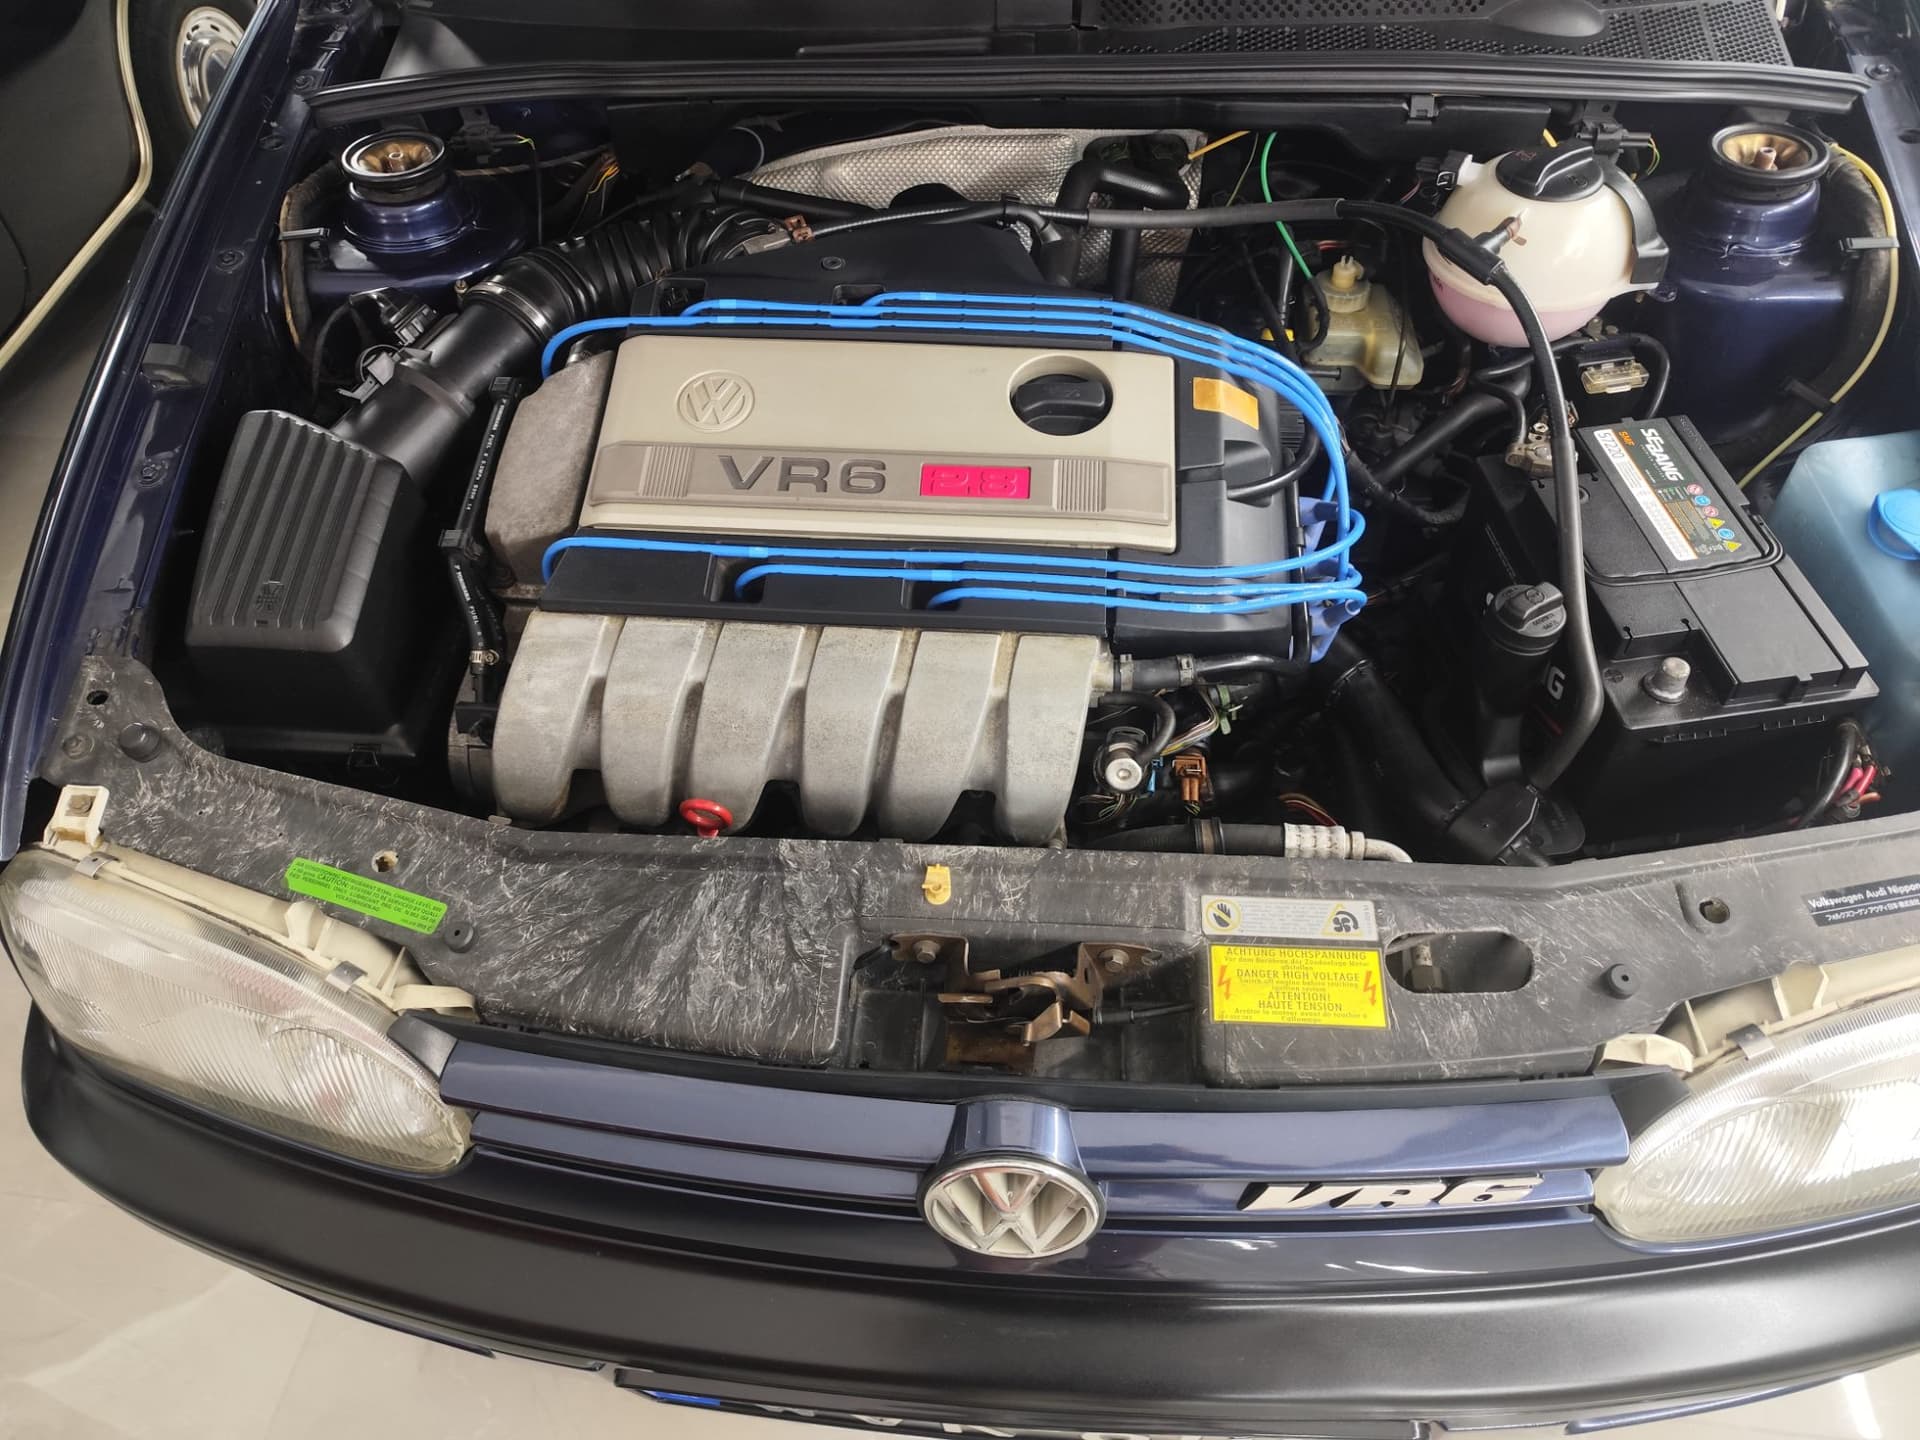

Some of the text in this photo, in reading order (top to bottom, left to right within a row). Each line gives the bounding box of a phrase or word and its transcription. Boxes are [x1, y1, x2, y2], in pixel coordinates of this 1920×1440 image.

[1640, 428, 1684, 481] SEBANG
[718, 454, 887, 495] VR6
[1807, 893, 1864, 909] Volkswagen
[1866, 886, 1888, 899] Audi
[1226, 947, 1367, 961] ACHTUNG HOCHSPANNUNG
[1236, 969, 1361, 982] DANGER HIGH VOLTAGE
[1267, 991, 1331, 1001] ATTENTION!
[1258, 1000, 1342, 1012] HAUTE TENSION
[1236, 1173, 1544, 1212] VR6
